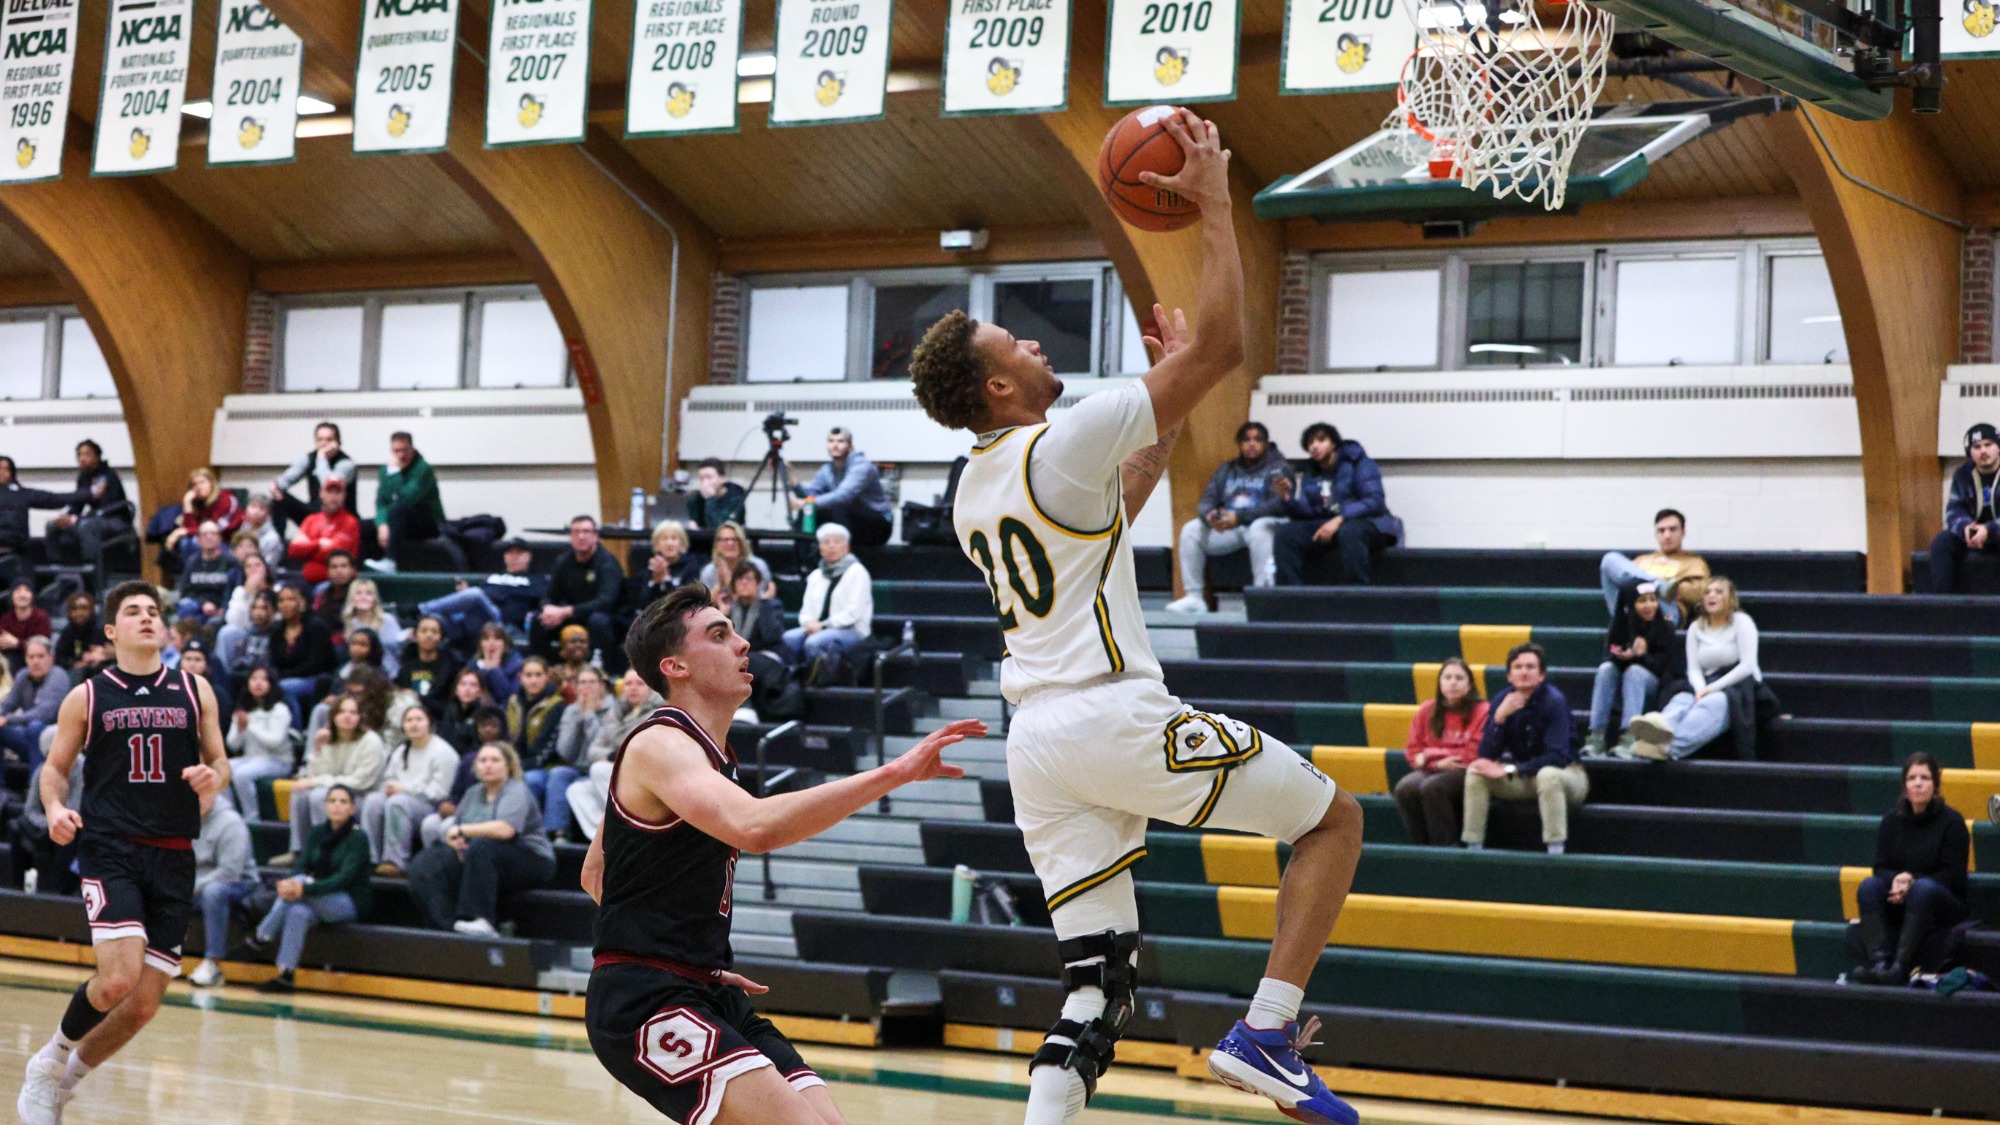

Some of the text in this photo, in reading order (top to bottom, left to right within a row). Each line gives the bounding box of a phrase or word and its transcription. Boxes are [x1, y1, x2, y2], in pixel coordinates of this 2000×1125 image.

[226, 4, 280, 34] NCA
[649, 0, 723, 17] REGIONALS
[811, 4, 860, 24] ROUND
[961, 0, 1002, 14] FIRST
[1140, 1, 1212, 35] 2010
[1318, 0, 1394, 23] 2010
[118, 14, 181, 47] NCAA
[505, 11, 576, 31] REGIONALS
[644, 17, 726, 39] FIRST PLACE
[969, 16, 1044, 49] 2009
[4, 28, 67, 59] NCAA
[221, 43, 297, 64] QUARTERFINALS
[367, 29, 449, 51] QUARTERFINALS
[500, 31, 577, 52] FIRST PLACE
[799, 25, 868, 58] 2009
[121, 51, 175, 69] NATIONALS
[506, 53, 566, 83] 2007
[652, 39, 716, 72] 2008
[6, 63, 61, 81] REGIONALS
[110, 69, 184, 89] FOURTH PLACE
[376, 63, 434, 94] 2005
[4, 81, 63, 100] FIRST PLACE
[121, 88, 170, 118] 2004
[227, 77, 282, 105] 2004
[11, 101, 54, 128] 1996
[970, 515, 1056, 634] 20
[102, 707, 187, 732] STEVENS
[128, 734, 166, 783] 11
[659, 1031, 693, 1058] S
